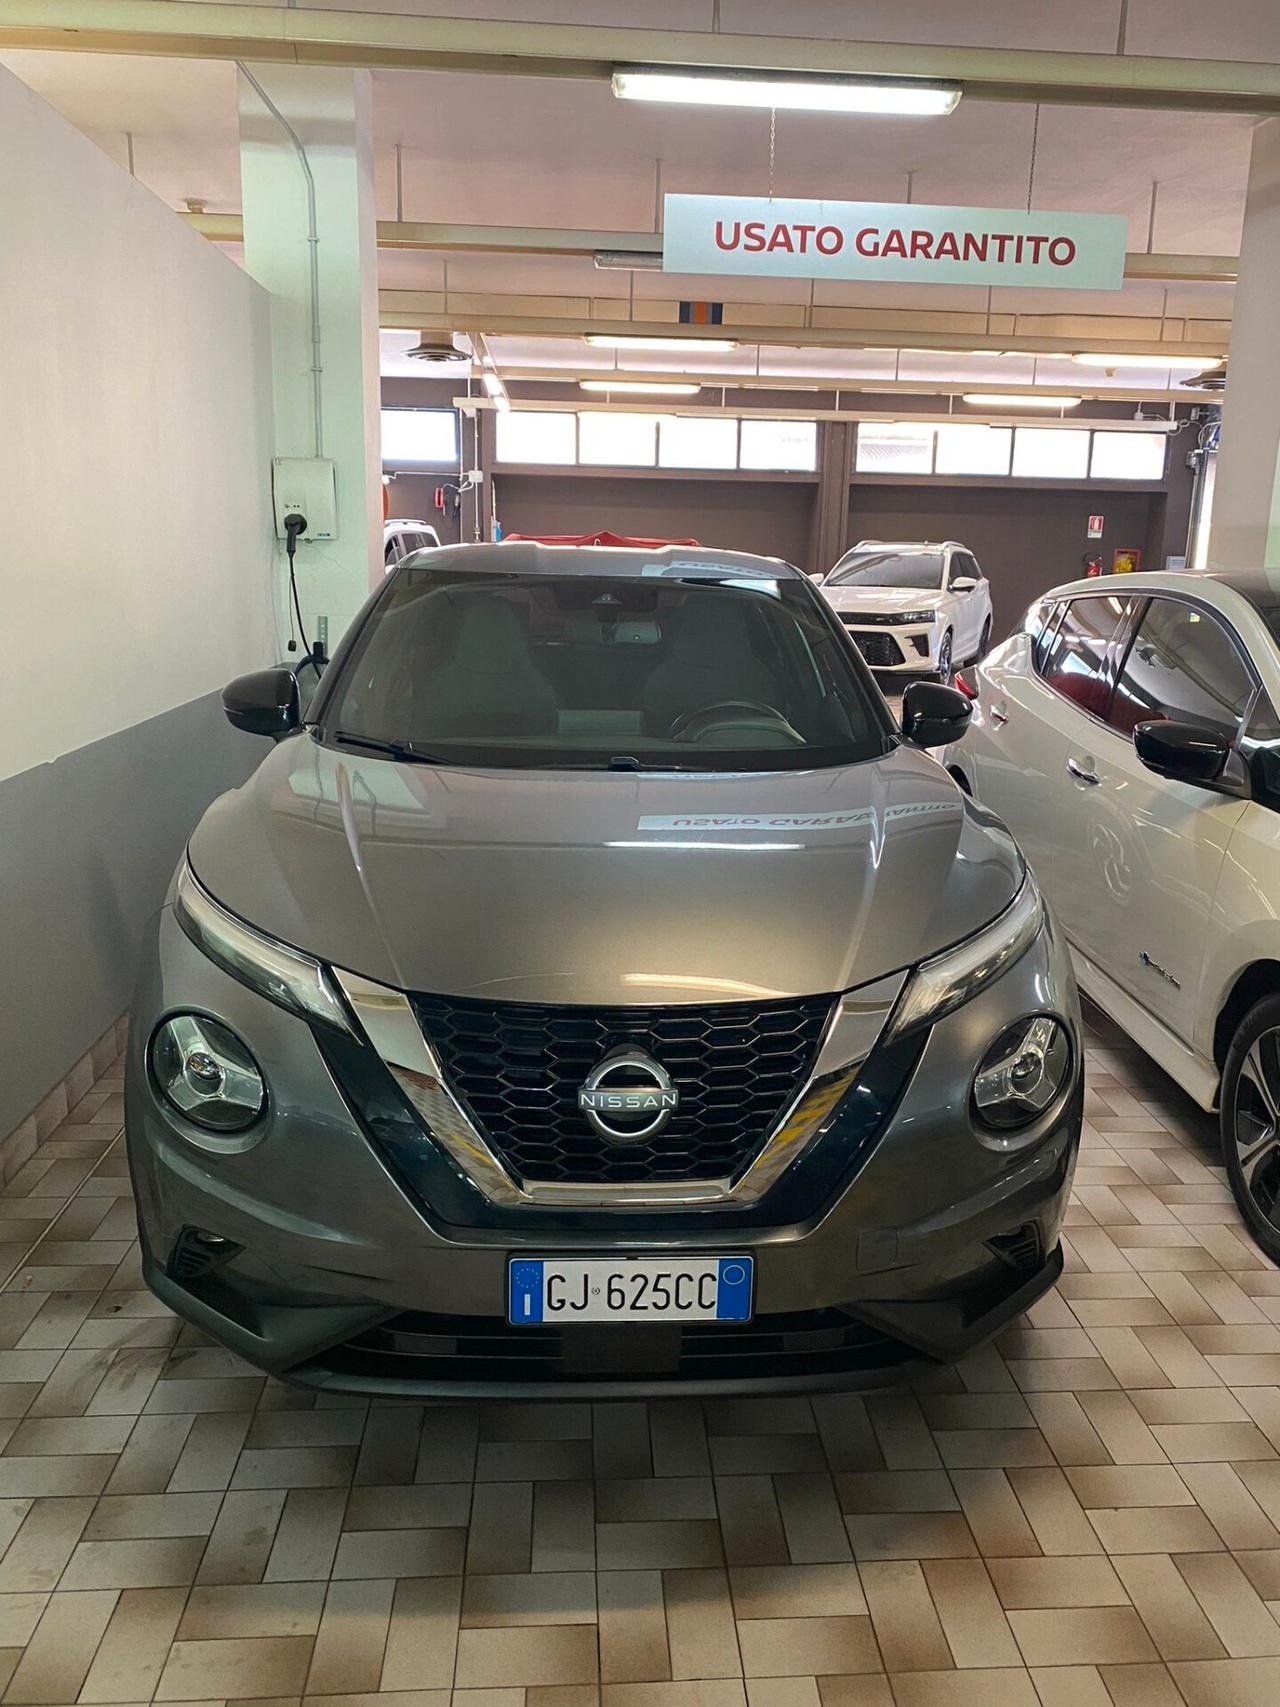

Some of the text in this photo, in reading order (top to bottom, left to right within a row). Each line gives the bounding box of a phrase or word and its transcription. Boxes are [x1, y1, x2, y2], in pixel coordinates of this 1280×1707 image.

[714, 221, 1076, 266] USATO GARANTITO
[581, 1093, 676, 1108] NISSAN
[547, 1274, 589, 1311] GJ
[607, 1273, 717, 1310] 625CC
